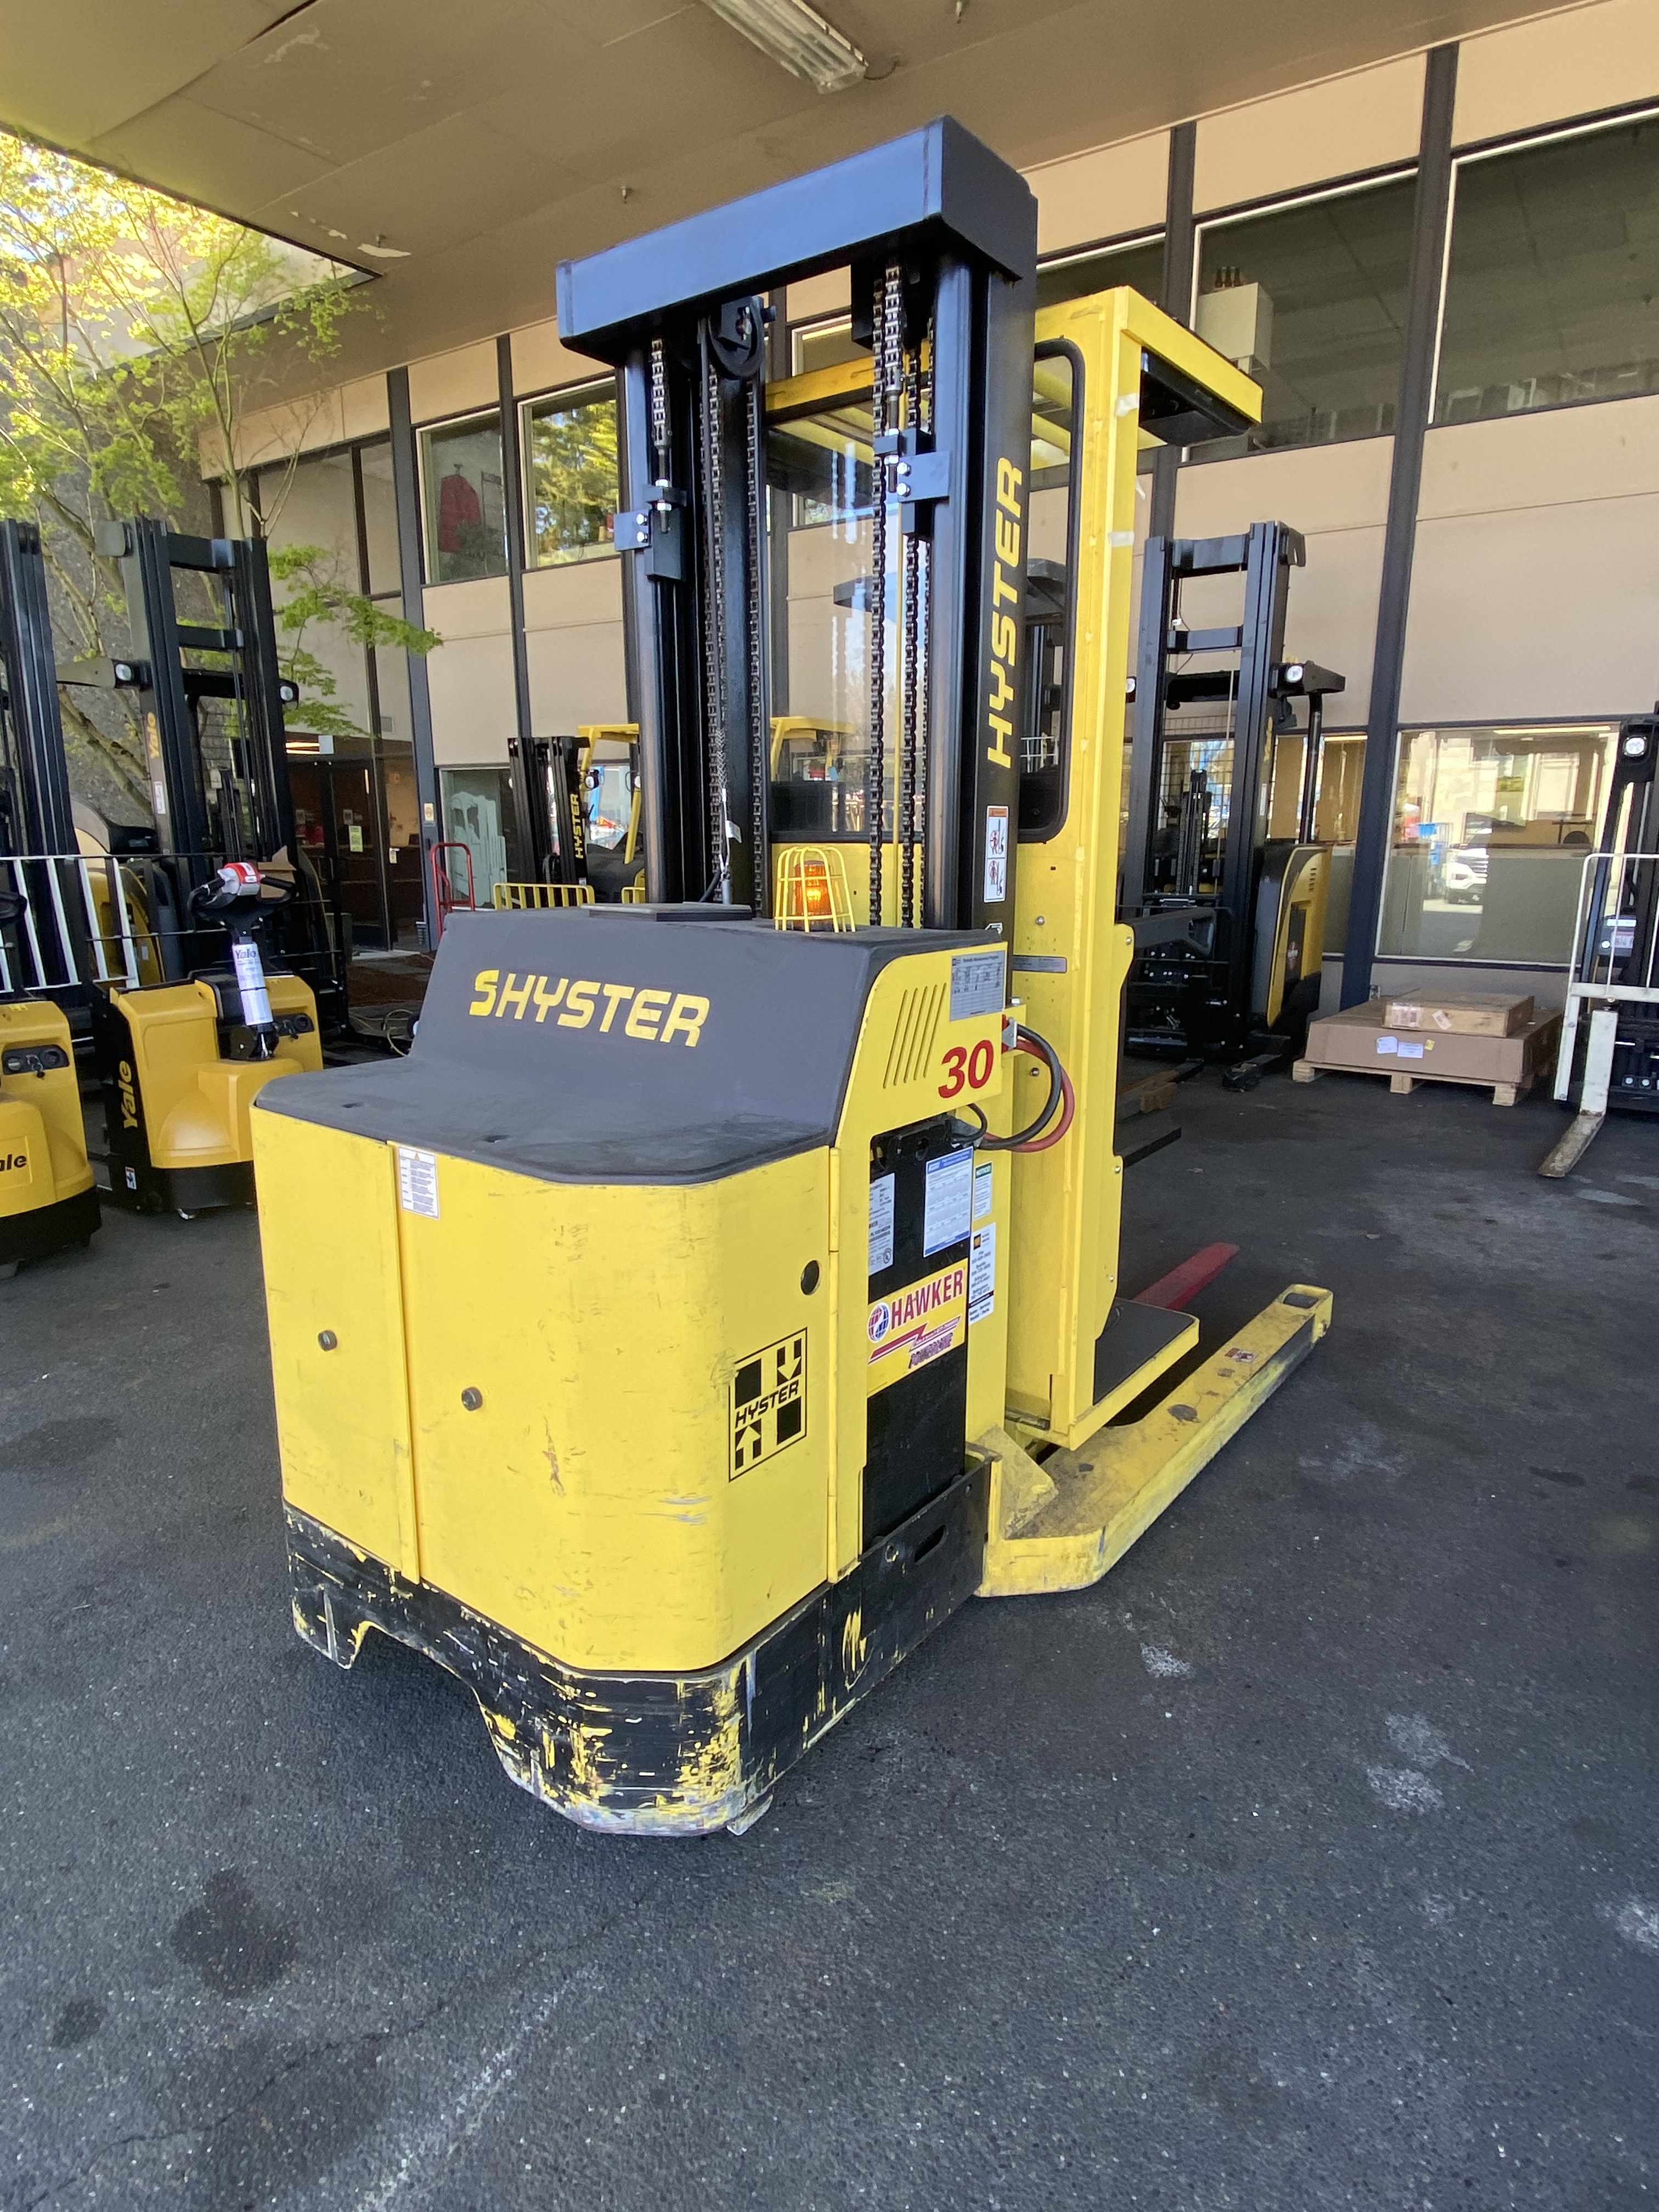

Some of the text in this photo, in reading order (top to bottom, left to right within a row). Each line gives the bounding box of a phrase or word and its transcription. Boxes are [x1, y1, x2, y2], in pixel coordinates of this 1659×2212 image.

[987, 456, 1024, 769] HYSTER
[570, 793, 584, 859] HYSTER
[235, 949, 257, 960] Yale
[469, 968, 710, 1047] SHYSTER
[118, 1060, 138, 1128] Yale
[938, 1039, 994, 1098] 30
[891, 1269, 964, 1330] HAWKER
[735, 1379, 799, 1429] HYSTER
